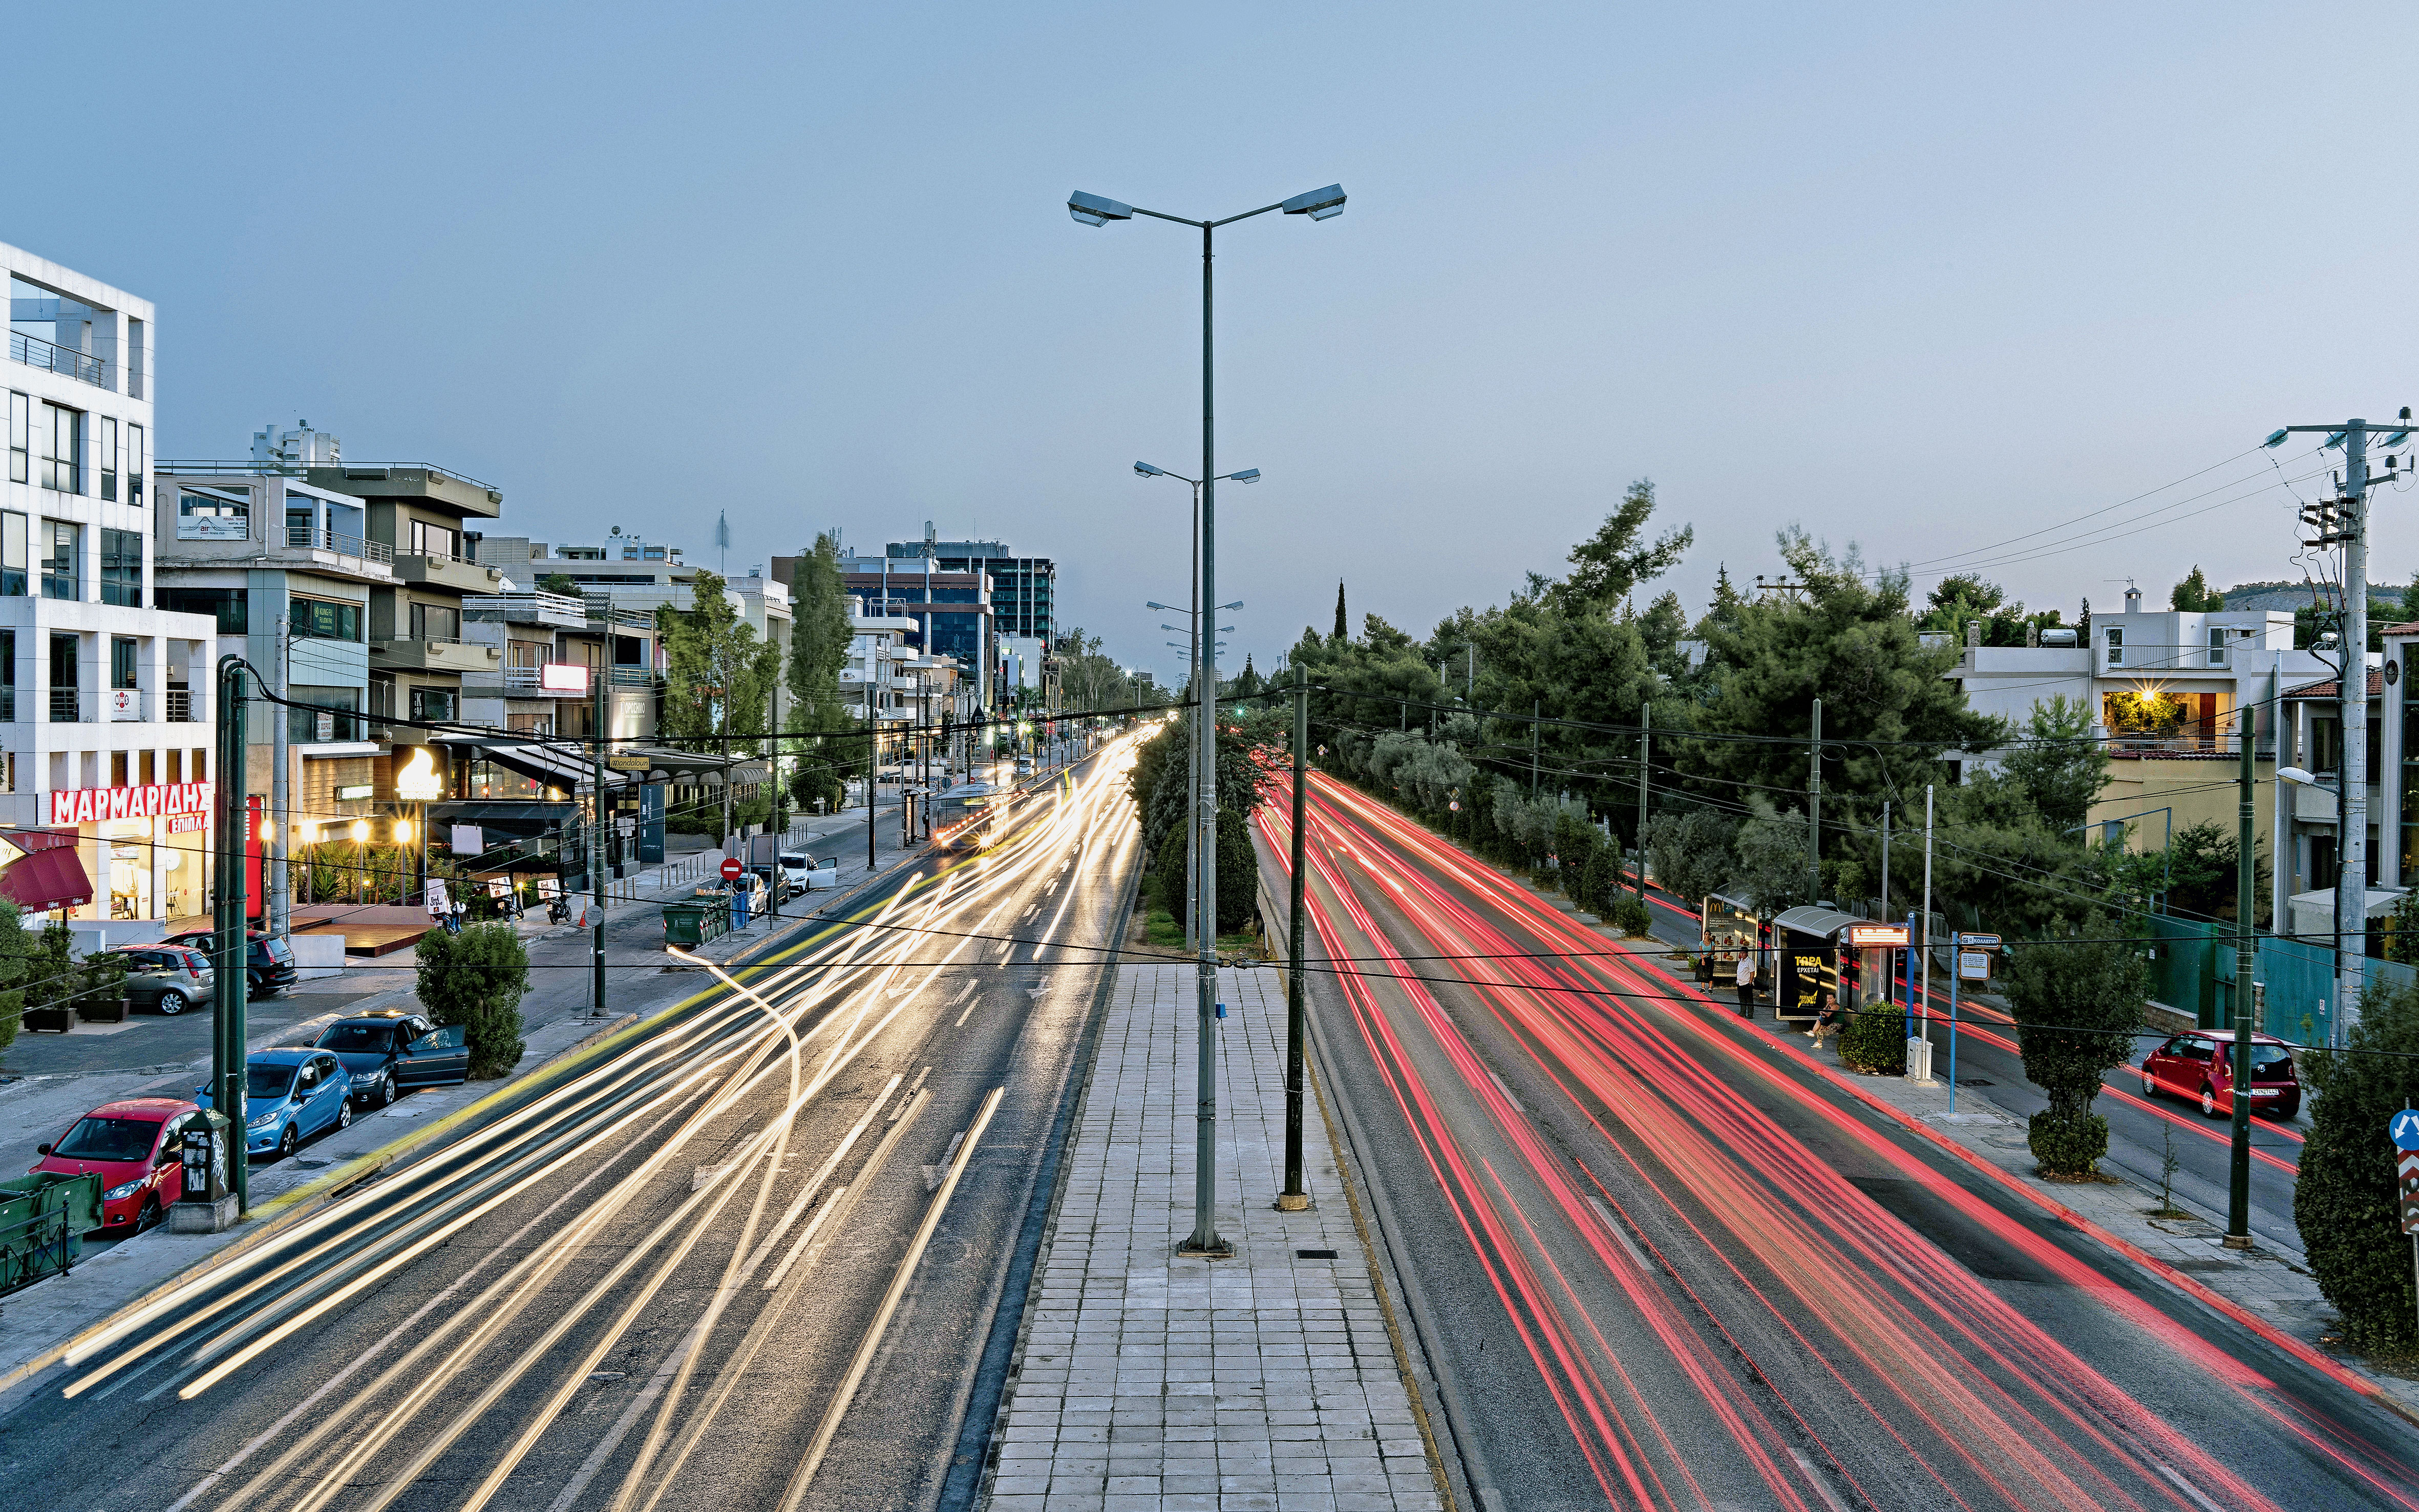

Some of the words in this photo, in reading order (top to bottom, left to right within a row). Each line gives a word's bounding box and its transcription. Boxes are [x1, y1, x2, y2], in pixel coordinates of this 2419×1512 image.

[625, 702, 645, 714] ΟΡΟΣΗΜΟ
[611, 758, 648, 766] mandaloun
[52, 783, 210, 824] ΜΑΡΜΑΡΙΔΗΣ
[169, 815, 210, 834] ΕΠΙΠΛΑ
[1794, 956, 1822, 966] ΤΩΡΑ
